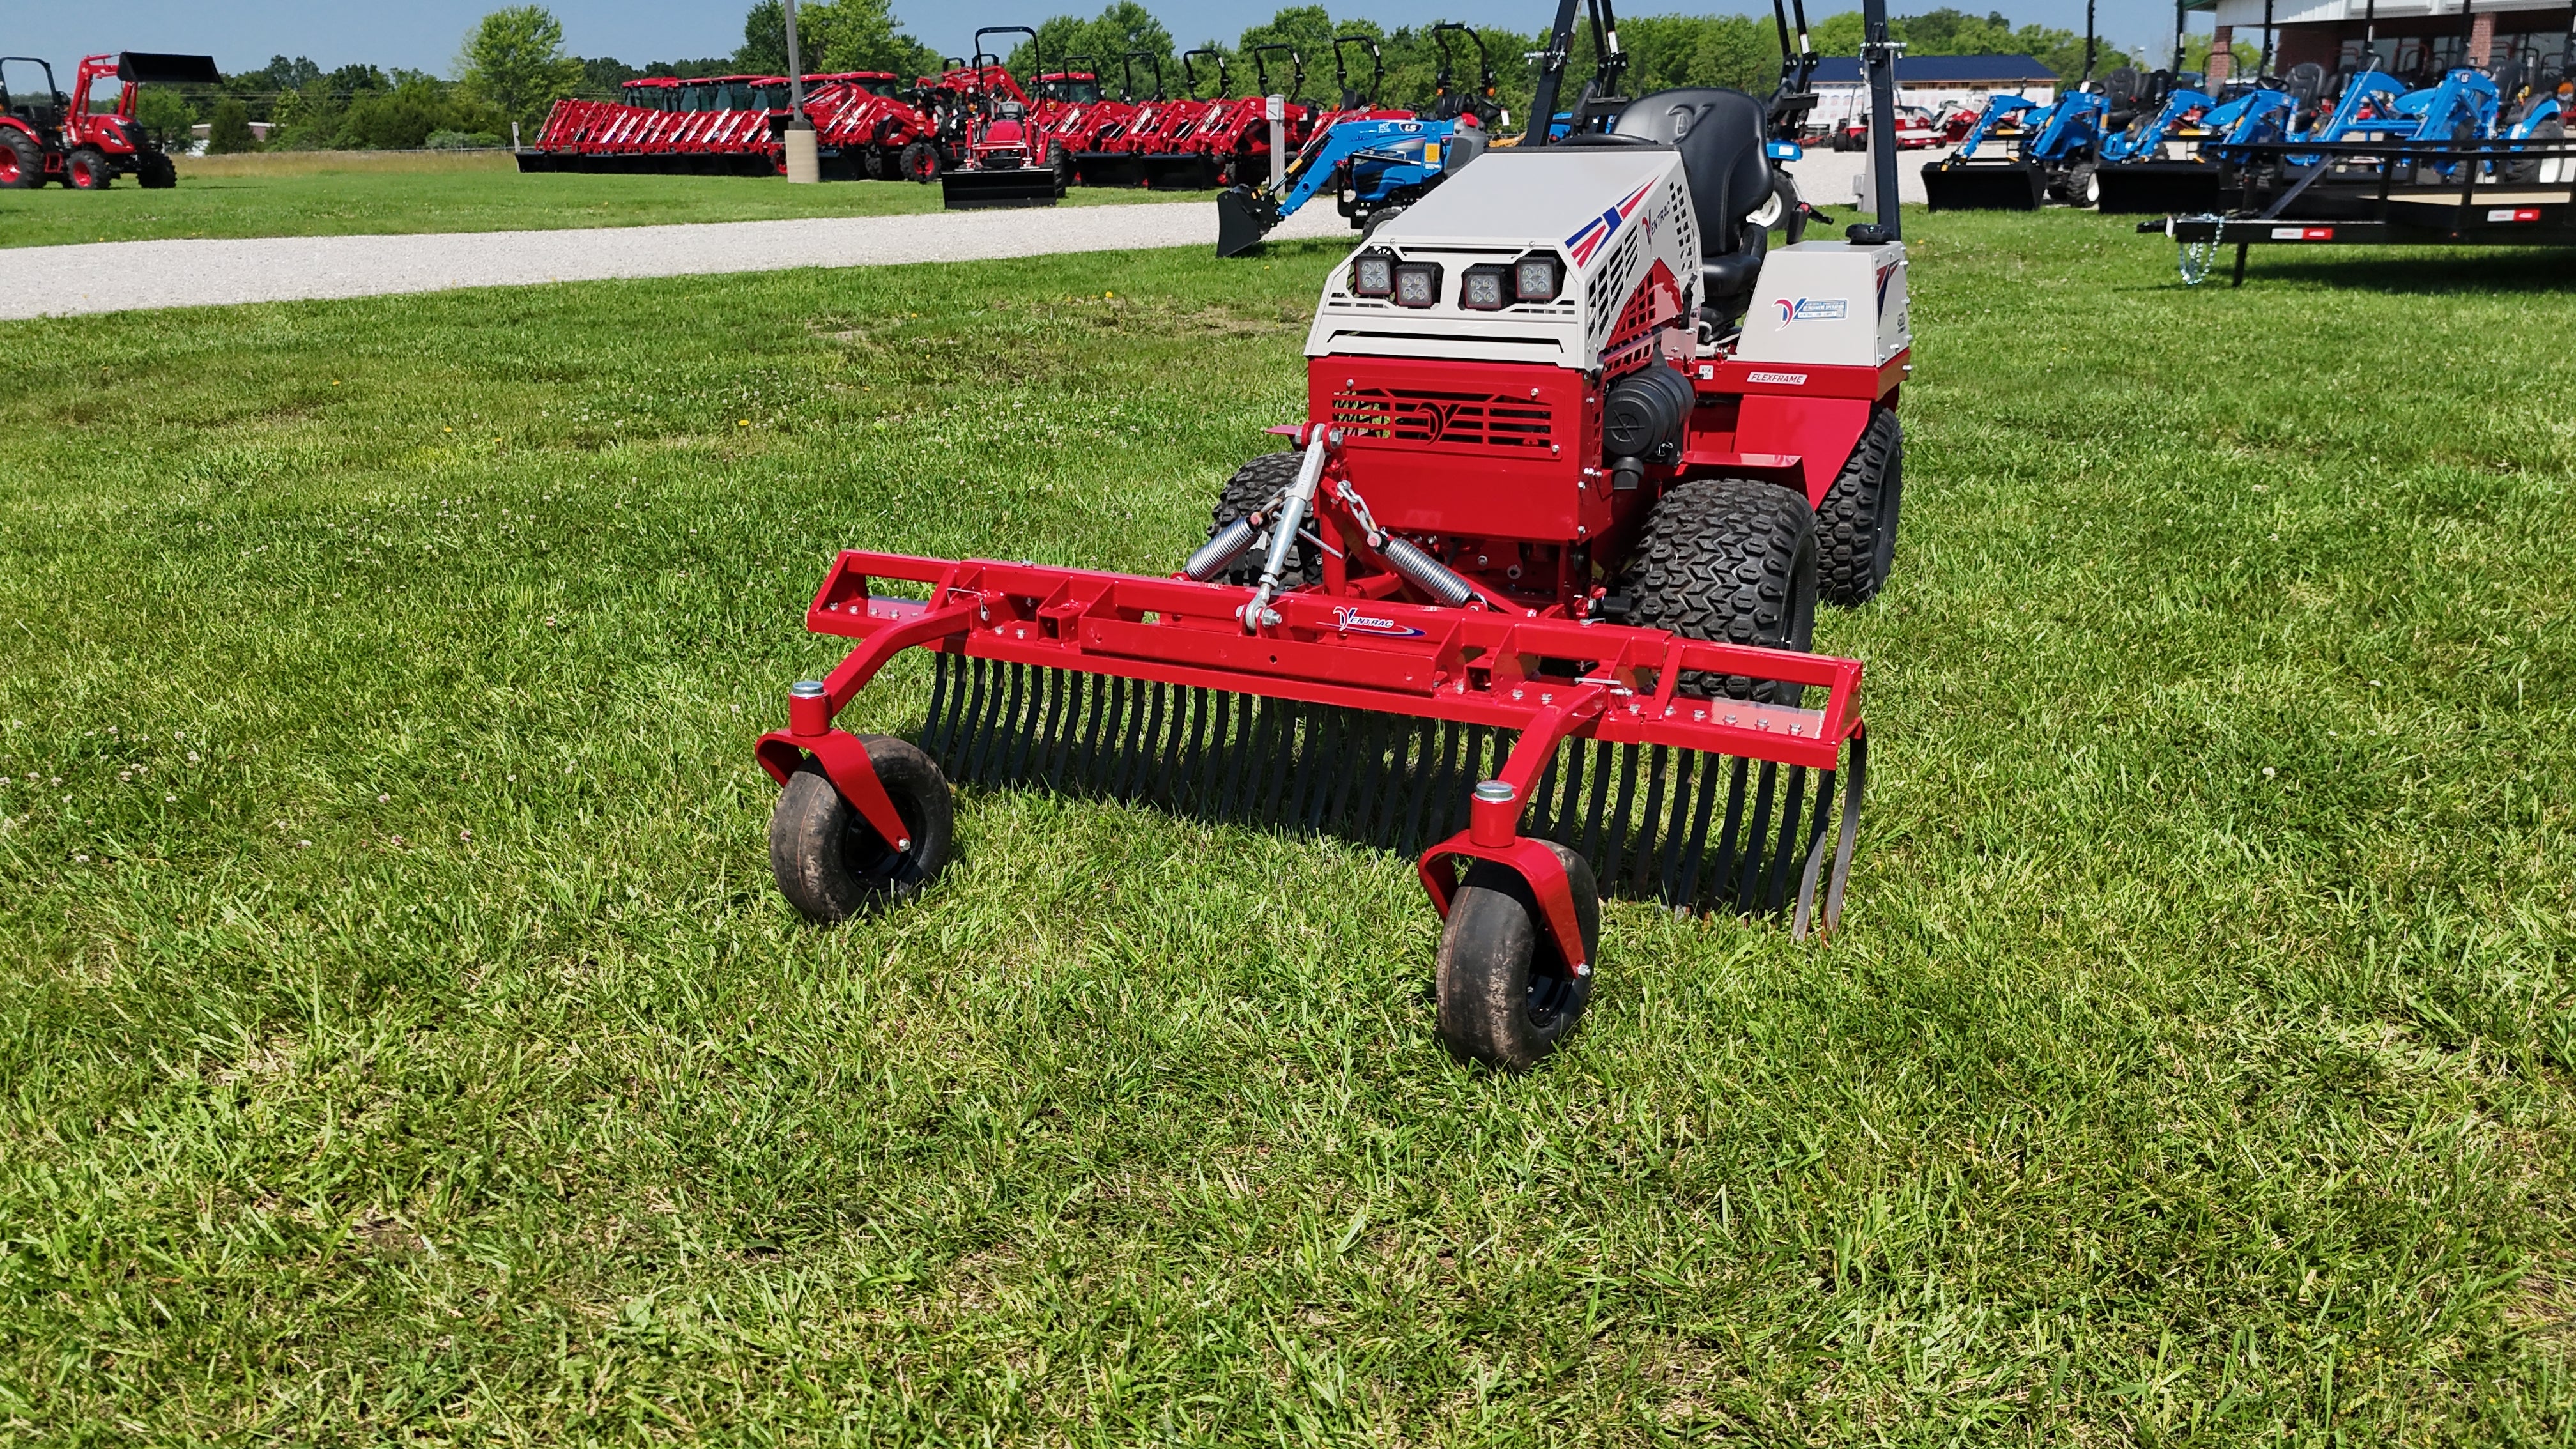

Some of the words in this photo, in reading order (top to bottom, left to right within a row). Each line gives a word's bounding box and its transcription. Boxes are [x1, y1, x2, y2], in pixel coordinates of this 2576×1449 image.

[1642, 200, 1670, 254] VENTRAC
[1751, 373, 1804, 383] FLEXFRAME
[1333, 606, 1394, 631] VENTRAC
